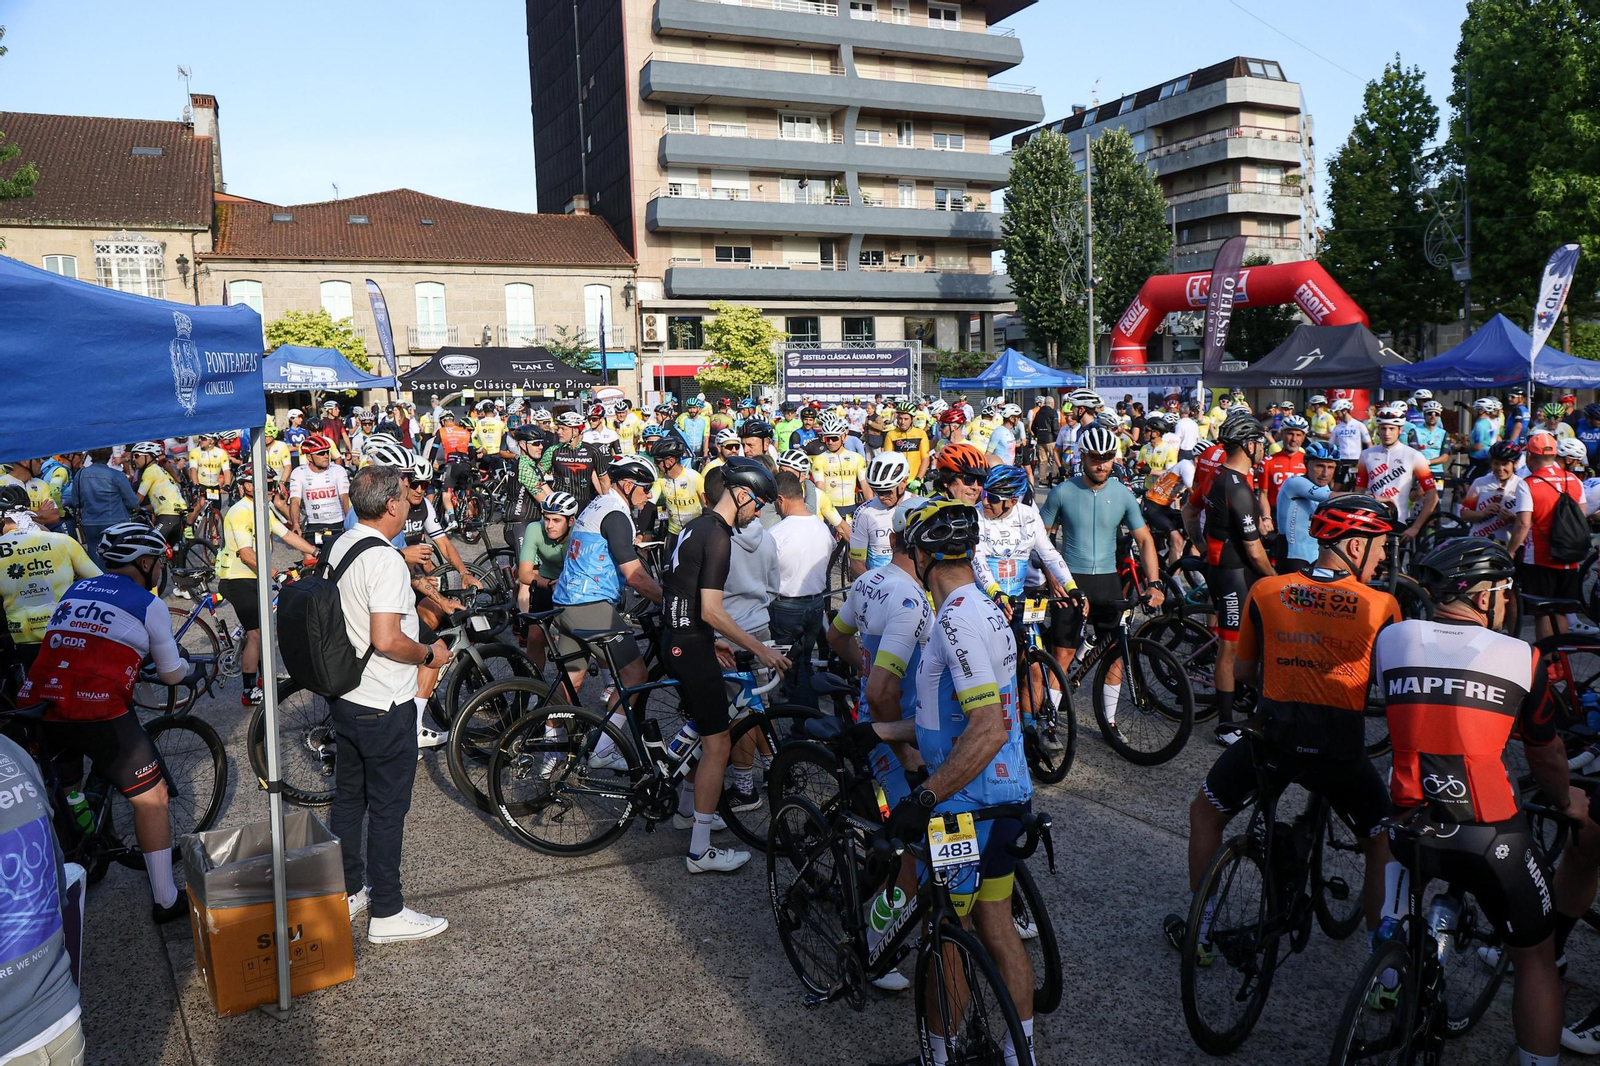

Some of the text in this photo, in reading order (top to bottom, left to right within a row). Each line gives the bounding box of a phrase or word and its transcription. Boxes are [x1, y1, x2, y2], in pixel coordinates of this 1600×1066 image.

[1296, 283, 1331, 324] FROIZ
[1118, 299, 1145, 334] FROIZ
[1208, 292, 1218, 333] GRUPO
[204, 351, 258, 373] PONTEAREAS
[852, 352, 875, 360] ÁLVARO
[204, 381, 234, 395] CONCELLO
[411, 380, 457, 390] Sestelo
[473, 379, 518, 390] Clásica
[522, 378, 561, 389] Álvaro
[566, 379, 591, 389] Pino
[1270, 377, 1303, 386] SESTELO
[1369, 463, 1389, 480] CLUB
[1370, 465, 1407, 493] TRIATLÓN
[305, 489, 337, 500] FROIZ
[16, 543, 52, 555] travel
[27, 558, 53, 571] chc
[87, 585, 119, 595] travel
[1289, 587, 1358, 604] BIKE OU
[74, 602, 116, 625] chc
[1288, 597, 1357, 614] NON VAI
[69, 619, 109, 634] energía
[62, 637, 87, 648] GDR
[1389, 676, 1506, 705] MAPFRE
[498, 804, 519, 828] MAVIC
[938, 841, 973, 858] 483
[1525, 856, 1553, 917] MAPFRE
[868, 895, 918, 966] cannondale
[16, 959, 31, 972] WE
[32, 944, 51, 963] NOW
